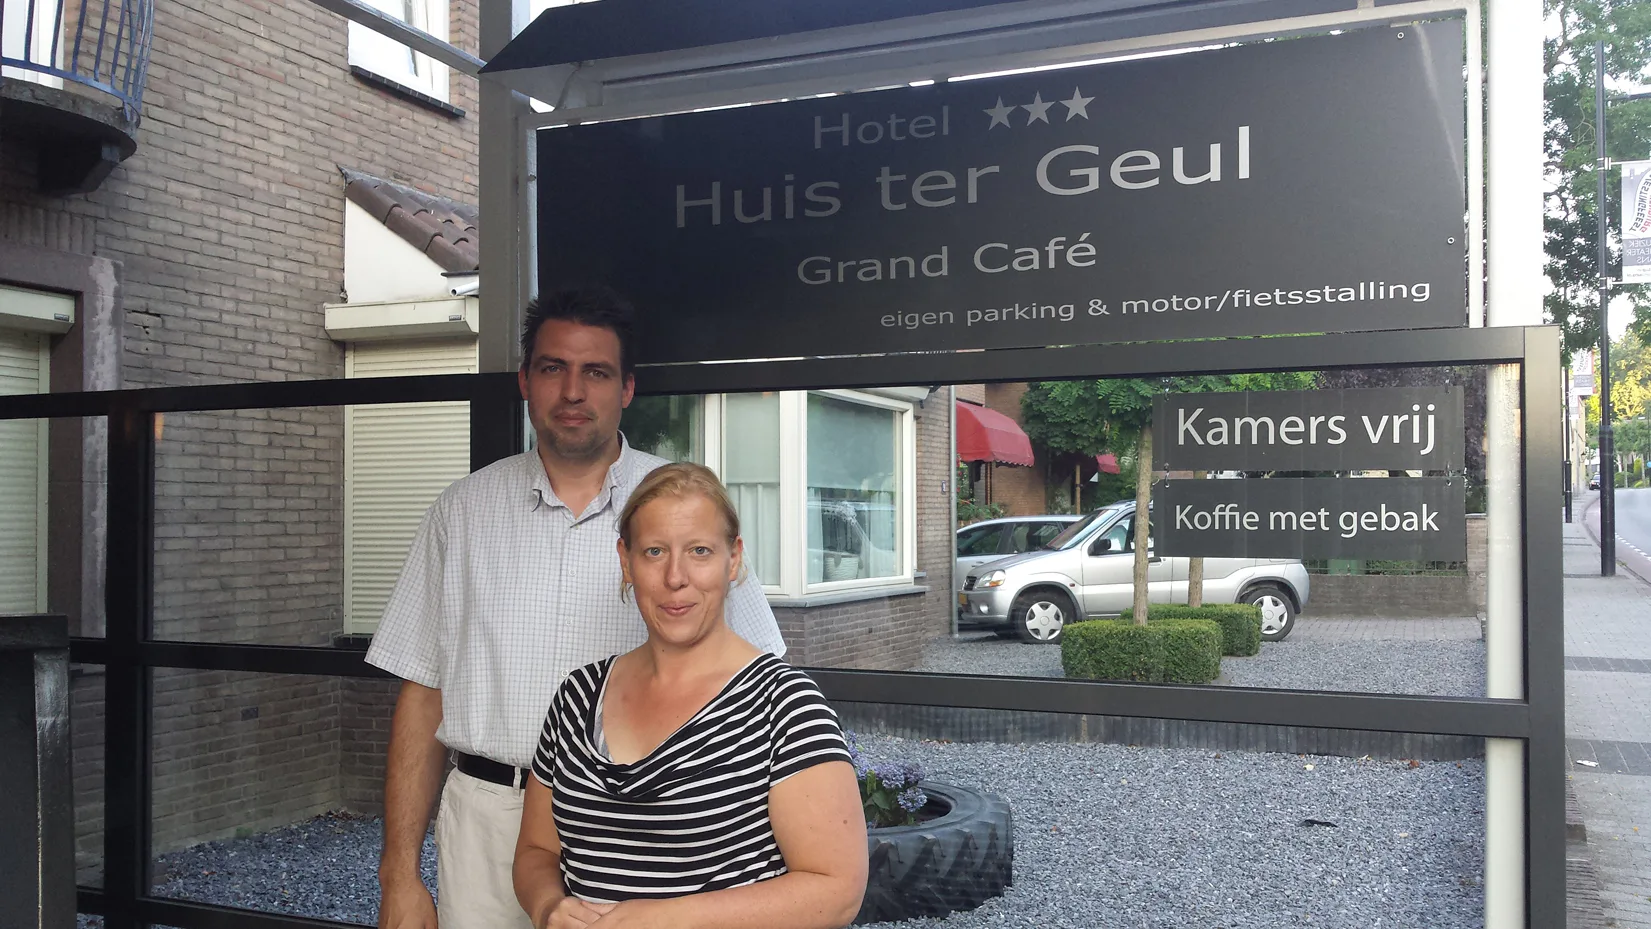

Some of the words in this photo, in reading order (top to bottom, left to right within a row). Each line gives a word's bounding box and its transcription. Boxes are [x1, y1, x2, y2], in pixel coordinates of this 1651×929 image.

[814, 105, 949, 149] Hotel
[676, 173, 841, 228] Huis
[876, 165, 1000, 211] ter
[1035, 125, 1250, 195] Geul
[797, 246, 949, 285] Grand
[973, 232, 1097, 273] Café
[880, 309, 954, 330] eigen
[967, 303, 1075, 328] parking
[1088, 298, 1110, 316] &
[1122, 281, 1430, 314] motor/fietsstalling
[1178, 407, 1347, 446] Kamers
[1361, 403, 1436, 455] vrij
[1175, 503, 1260, 531] Koffie
[1269, 507, 1330, 531] met
[1338, 503, 1440, 538] gebak
